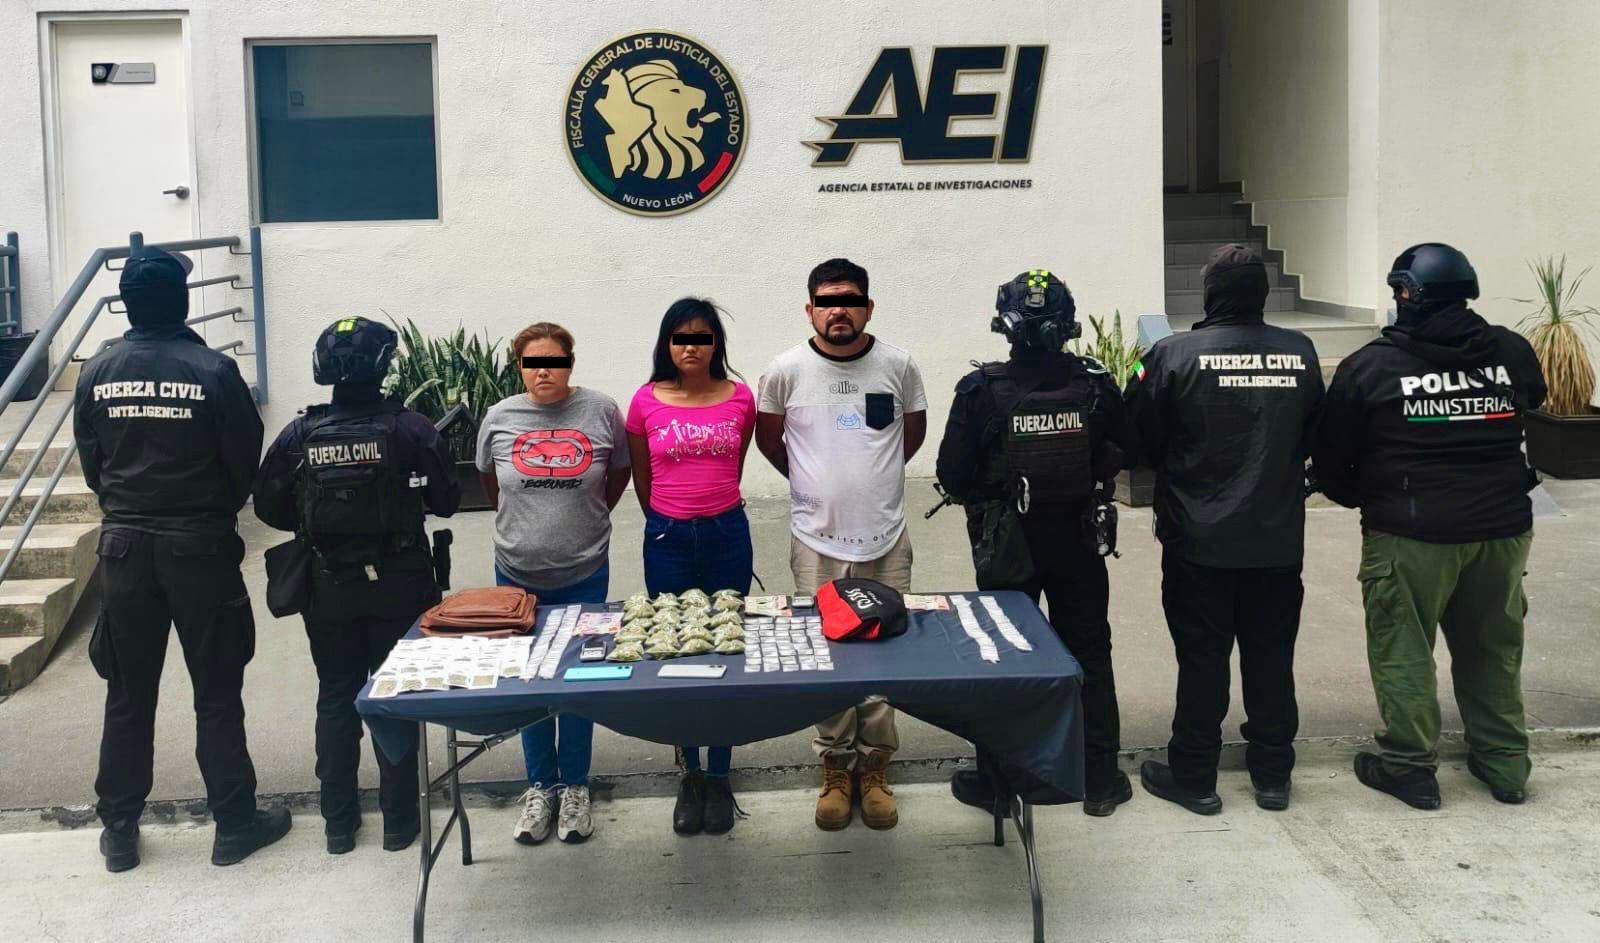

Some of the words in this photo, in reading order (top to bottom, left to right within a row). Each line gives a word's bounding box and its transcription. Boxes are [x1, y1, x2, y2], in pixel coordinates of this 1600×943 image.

[570, 90, 587, 149] FISCALÍA
[581, 44, 632, 88] GENERAL
[634, 37, 654, 49] DE
[655, 37, 709, 68] JUSTICIA
[708, 65, 730, 91] DEL
[723, 91, 741, 145] ESTADO
[800, 44, 1048, 167] AEI
[818, 183, 868, 193] AGENCIA
[870, 182, 914, 192] ESTATAL
[917, 182, 932, 191] DE
[934, 179, 1033, 191] INVESTIGACIONES
[623, 194, 661, 208] NUEVO
[664, 191, 694, 208] LEÓN
[1199, 354, 1263, 370] FUERZA
[1265, 354, 1306, 370] CIVIL
[93, 381, 156, 401] FUERZA
[160, 381, 206, 401] CIVIL
[1218, 375, 1298, 387] INTELIGENCIA
[107, 405, 193, 419] INTELIGENCIA
[1403, 396, 1515, 416] MINISTERIAL
[1013, 414, 1055, 433] FUERZA
[1055, 412, 1083, 430] CIVIL
[308, 445, 352, 465] FUERZA
[352, 441, 381, 460] CIVIL
